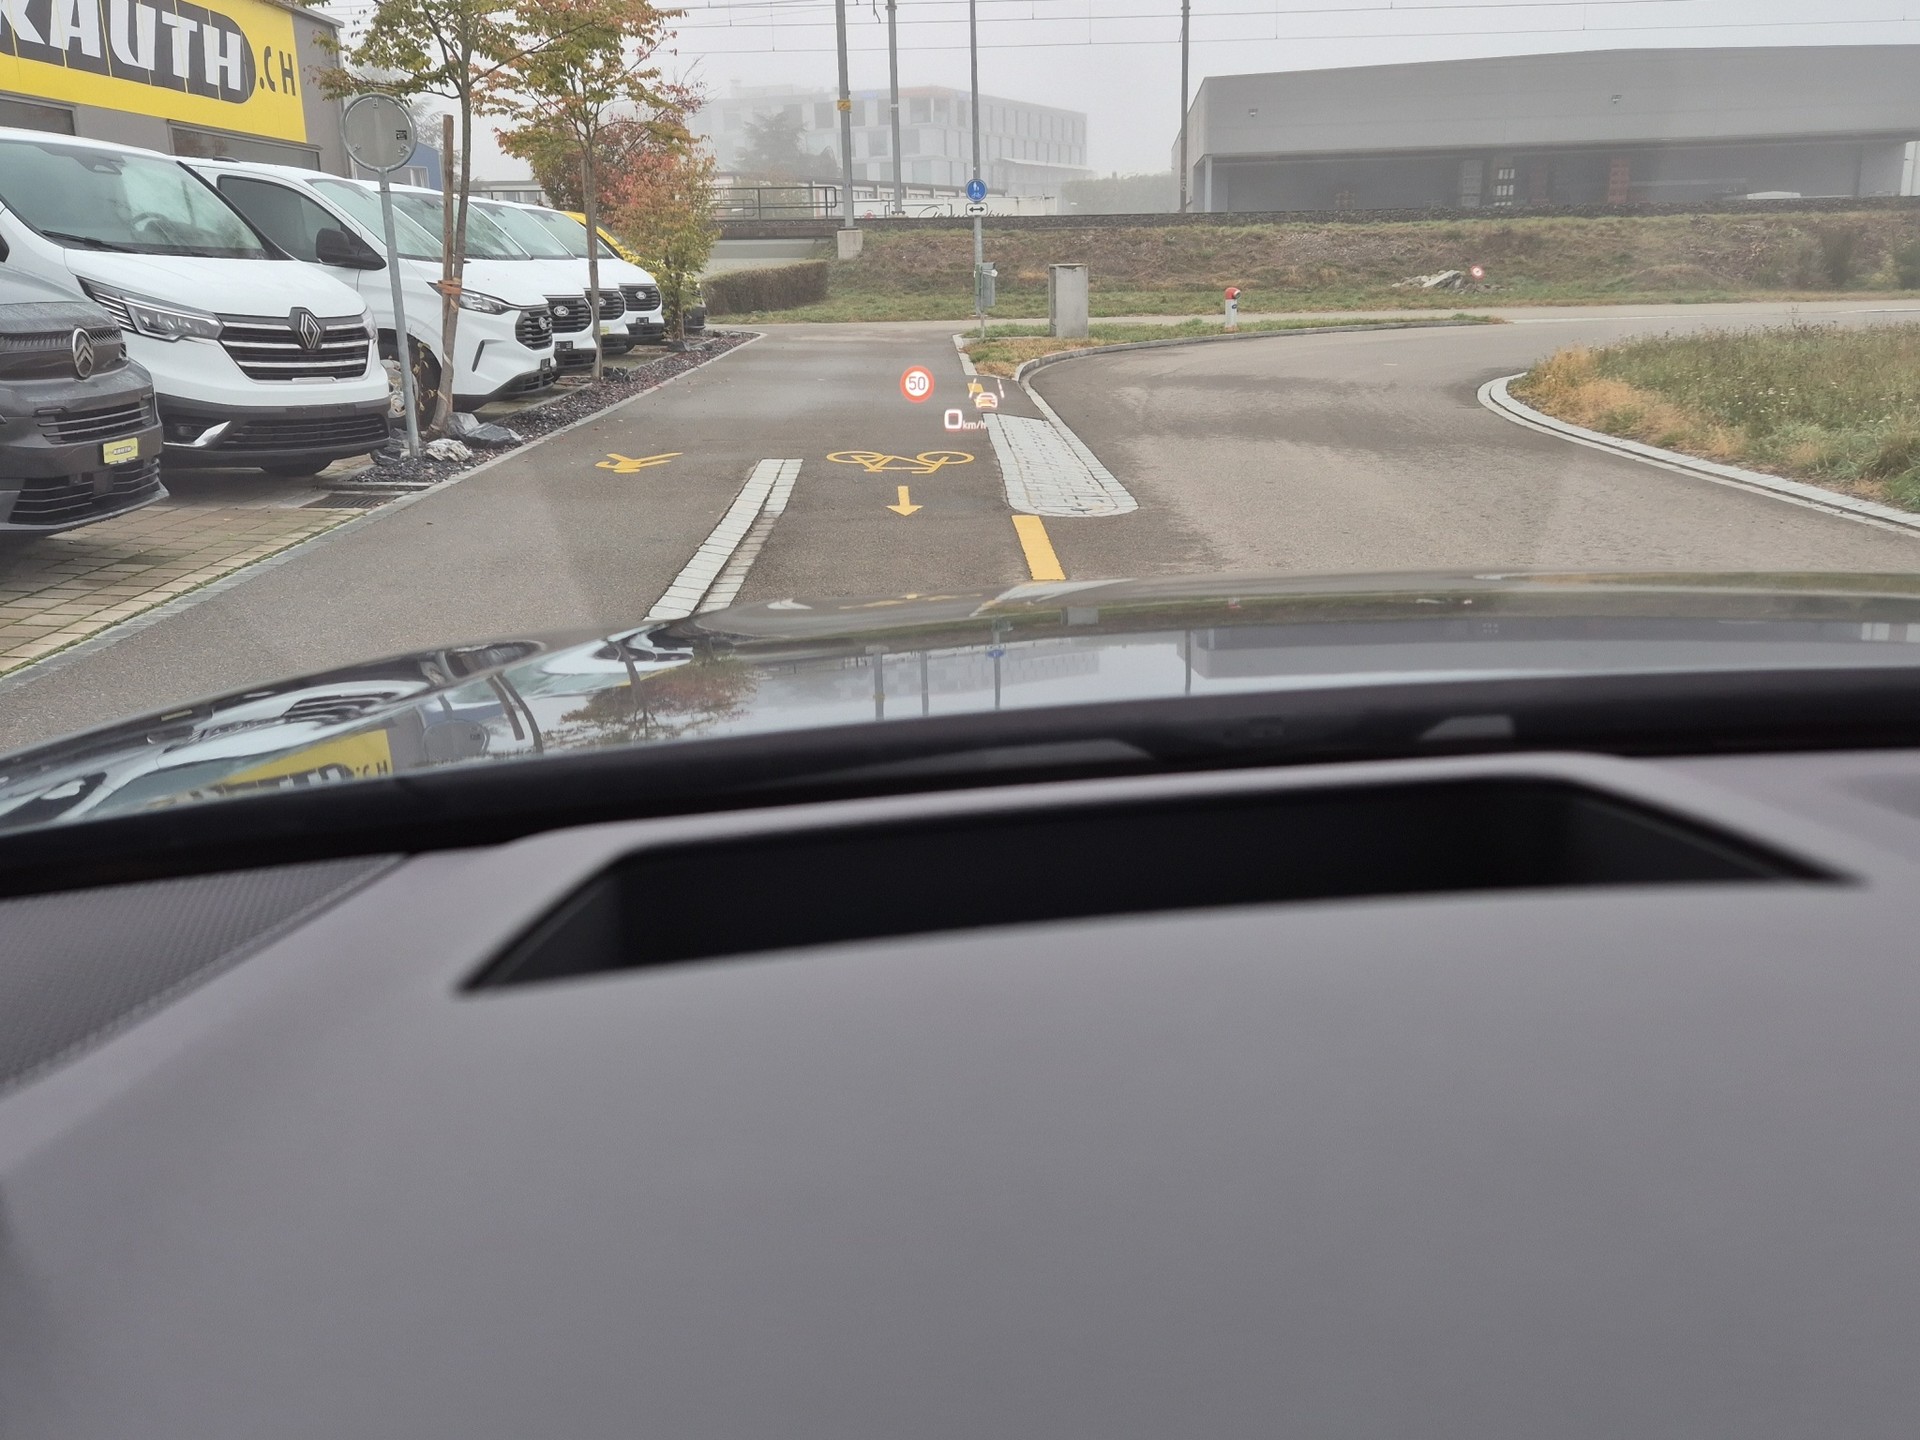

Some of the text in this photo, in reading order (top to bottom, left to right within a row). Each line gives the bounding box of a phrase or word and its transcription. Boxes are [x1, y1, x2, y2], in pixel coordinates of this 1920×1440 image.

[908, 376, 926, 391] 50
[944, 408, 987, 430] 0 km/h
